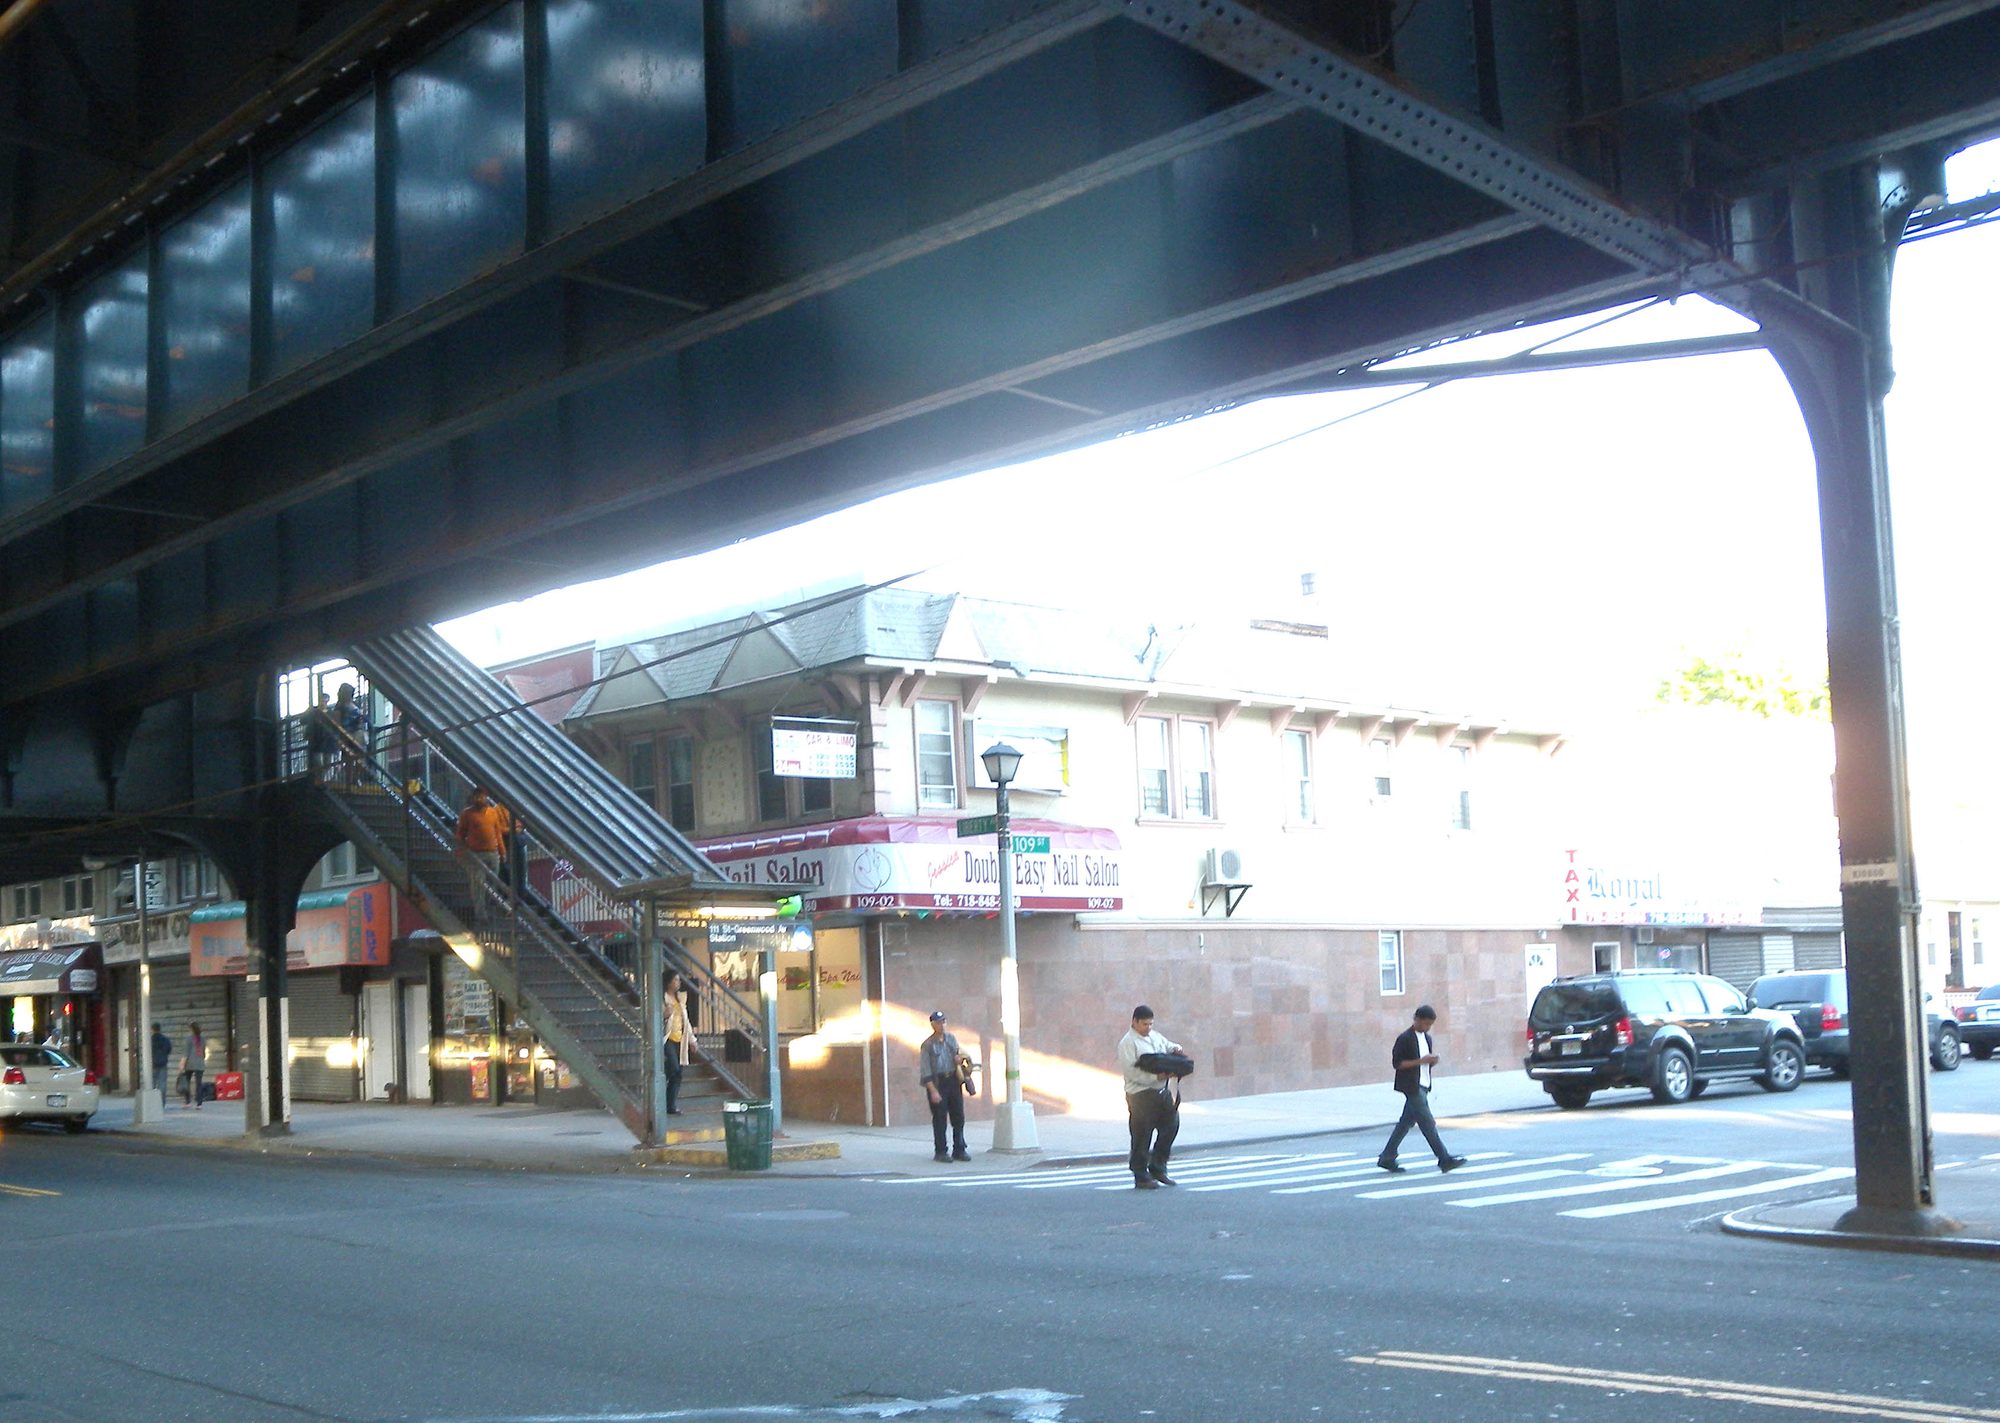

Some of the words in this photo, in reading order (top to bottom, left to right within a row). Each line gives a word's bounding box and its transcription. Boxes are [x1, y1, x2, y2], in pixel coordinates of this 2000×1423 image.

[1015, 837, 1036, 852] 109
[767, 857, 824, 887] Salon
[964, 850, 1001, 884] Doub
[1015, 853, 1047, 894] Easy
[1053, 854, 1079, 886] Nail
[1085, 855, 1119, 887] Salon
[1564, 849, 1580, 921] TAXI
[1587, 867, 1663, 907] Royal
[857, 896, 895, 908] 109-02
[934, 894, 953, 907] Tel:
[1087, 898, 1115, 909] 109-02
[710, 934, 737, 943] Station
